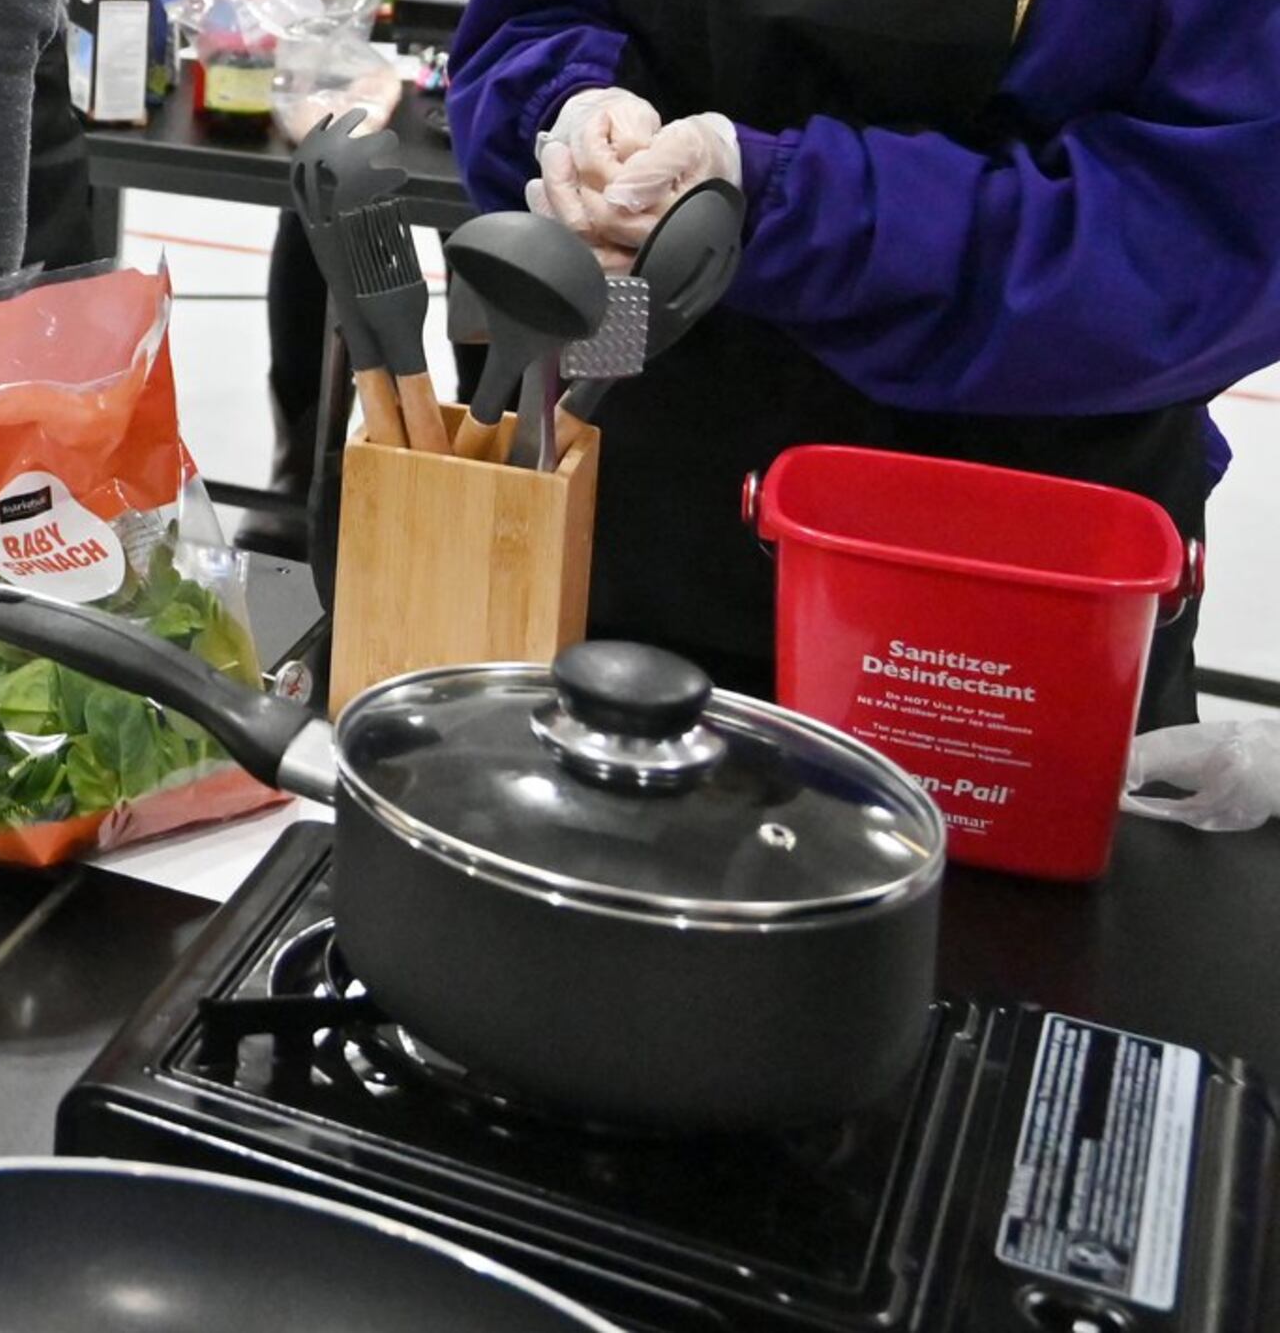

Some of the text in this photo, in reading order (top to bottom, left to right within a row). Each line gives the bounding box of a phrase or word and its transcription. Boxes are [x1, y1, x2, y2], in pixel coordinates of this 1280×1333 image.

[2, 522, 66, 559] BABY
[2, 539, 109, 576] SPINACH
[889, 639, 1012, 676] Sanitizer
[903, 694, 930, 706] NOT
[909, 773, 1009, 805] en-Pail
[942, 812, 989, 829] amar
